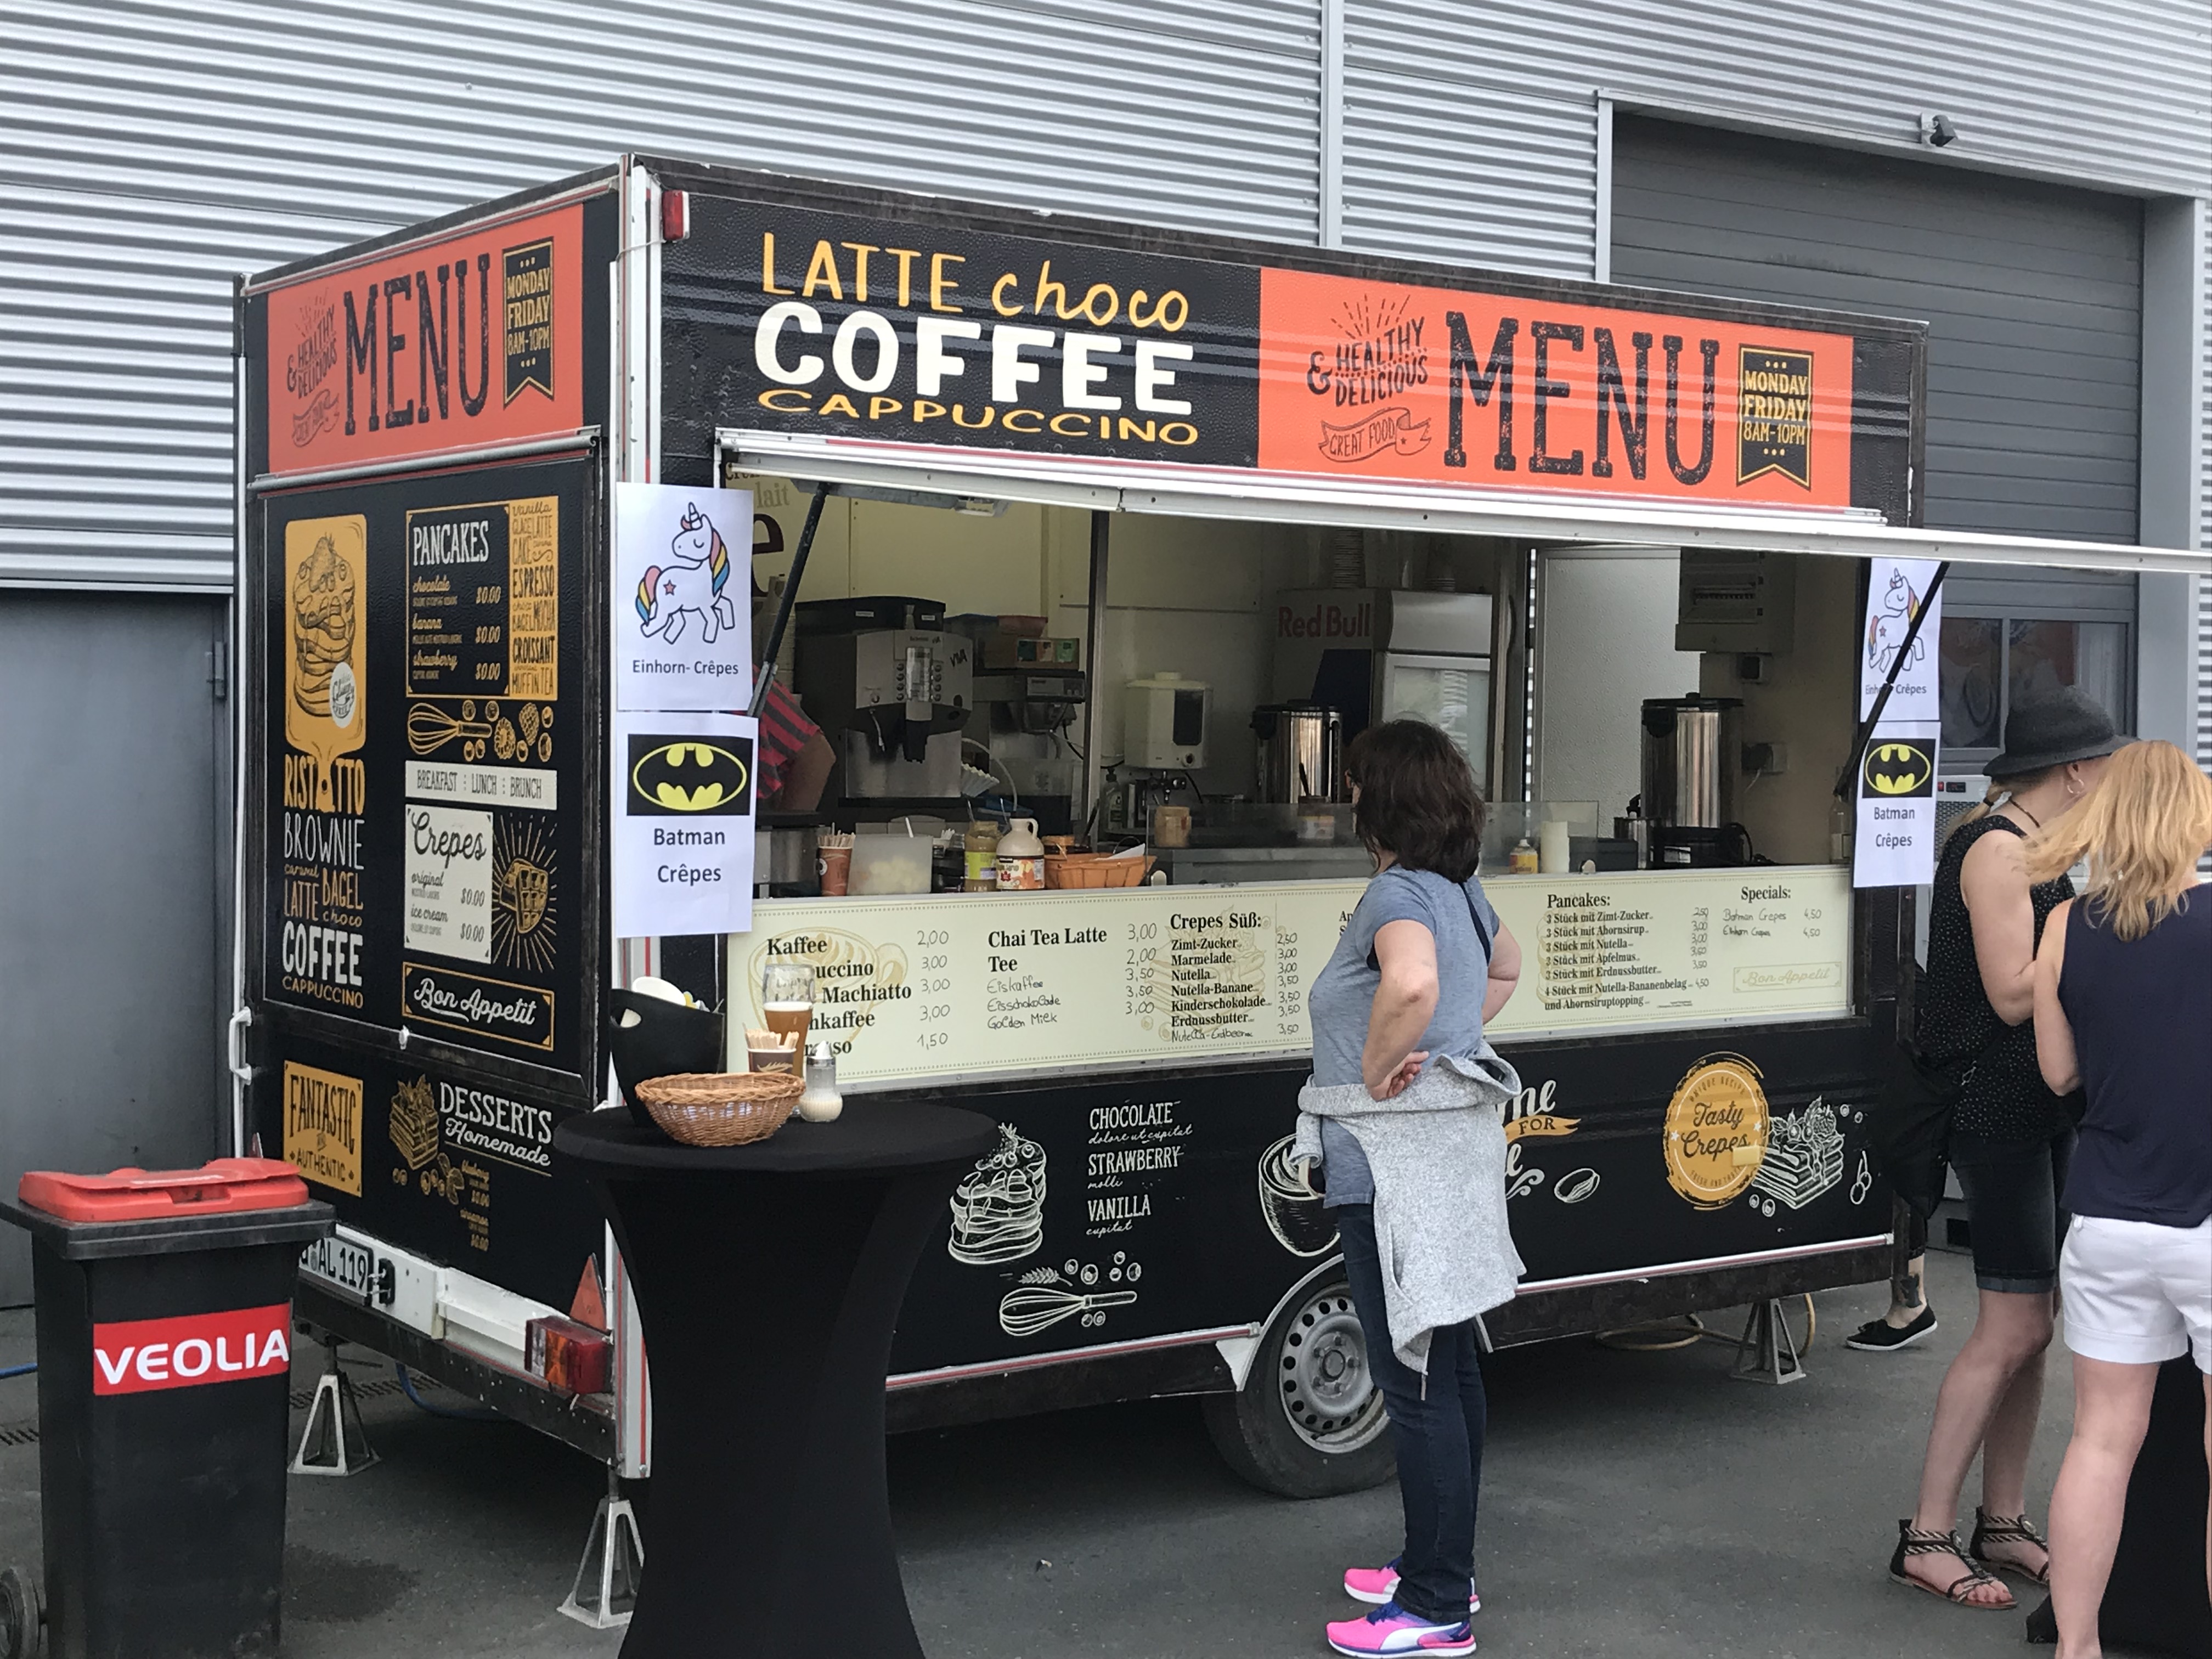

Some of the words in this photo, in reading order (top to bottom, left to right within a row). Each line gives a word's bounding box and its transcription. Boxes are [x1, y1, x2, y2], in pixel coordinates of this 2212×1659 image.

[506, 267, 550, 299] MONDAY
[763, 233, 966, 313] LATTE
[992, 261, 1189, 331] choco
[507, 295, 550, 329] FRIDAY
[344, 253, 490, 436] MENU
[507, 326, 550, 356] 8AM-10PM
[1336, 316, 1425, 371] HEALTHY
[755, 301, 1193, 415] COFFEE
[1307, 351, 1333, 394] &
[1335, 355, 1427, 407] DELICIOUS
[1744, 368, 1808, 396] MONDAY
[1444, 311, 1719, 484] MENU
[1743, 393, 1807, 422] FRIDAY
[758, 389, 1199, 445] CAPPUCCINO
[1369, 417, 1395, 448] FOOD
[1742, 420, 1806, 445] 8AM-10PM
[755, 481, 790, 509] lait
[413, 521, 489, 566] PANCAKES
[513, 565, 555, 598] ESPRESSO
[1278, 605, 1322, 638] Red
[1326, 603, 1370, 638] Bull
[512, 635, 555, 664] CROISSANT
[632, 659, 691, 675] Einhorn-
[694, 659, 739, 678] Crêpes
[1896, 684, 1927, 696] Crêpes
[417, 770, 458, 792] BREAKFAST
[472, 773, 497, 795] LUNCH
[510, 776, 542, 799] BRUNCH
[1874, 807, 1915, 820] Batman
[284, 812, 364, 870] BROWNIE
[409, 810, 487, 868] Crepes
[653, 827, 725, 847] Batman
[1876, 834, 1912, 848] Crêpes
[411, 871, 444, 889] original
[461, 888, 485, 907] $0.00
[657, 865, 722, 885] Crêpes
[284, 878, 319, 921] LATTE
[1547, 893, 1610, 908] Pancakes:
[1741, 885, 1791, 904] Specials:
[323, 909, 362, 927] choco
[411, 904, 422, 918] ice
[424, 909, 448, 922] cream
[1171, 913, 1222, 932] Crepes
[1229, 912, 1262, 928] Süß:
[1554, 912, 1578, 923] Stück
[1581, 911, 1595, 923] mit
[767, 936, 828, 956] Kaffee
[917, 930, 949, 947] 2,00
[988, 930, 1026, 947] Chai
[1031, 929, 1059, 945] Tea
[1065, 927, 1107, 944] Latte
[1127, 923, 1157, 943] 3,00
[1553, 940, 1577, 952] Stück
[1580, 940, 1594, 950] mit
[1596, 938, 1627, 949] Nutella
[1554, 927, 1578, 937] Stück
[1581, 926, 1595, 936] mit
[283, 921, 363, 987] COFFEE
[921, 955, 947, 970] 3,00
[988, 956, 1018, 972] Tee
[1127, 947, 1156, 966] 2,00
[1171, 952, 1232, 966] Marmelade
[1278, 948, 1297, 960] 3,00
[1553, 955, 1577, 966] Stück
[1580, 953, 1594, 964] mit
[1125, 968, 1154, 981] 3,50
[1171, 969, 1210, 981] Nutella
[1278, 962, 1297, 974] 3,00
[1553, 969, 1577, 979] Stück
[1579, 967, 1594, 978] mit
[283, 975, 363, 1009] CAPPUCCINO
[822, 984, 912, 1003] Machiatto
[920, 979, 951, 994] 3,00
[1125, 986, 1153, 998] 3,50
[1171, 983, 1254, 997] Nutella-Banane
[1278, 975, 1299, 988] 3,50
[1552, 985, 1577, 996] Stück
[1579, 983, 1593, 994] mit
[414, 978, 461, 1015] Bon
[461, 989, 537, 1025] Appetit
[919, 1004, 951, 1022] 3,00
[1125, 1001, 1154, 1015] 3,00
[1171, 996, 1266, 1012] Kinderschokolade
[1278, 991, 1300, 1004] 3,50
[1545, 999, 1561, 1011] und
[1171, 1013, 1249, 1028] Erdnussbutter
[1278, 1005, 1300, 1017] 3,50
[1278, 1023, 1299, 1035] 3,50
[917, 1032, 948, 1048] 1,50
[289, 1075, 356, 1155] FANTASTIC
[440, 1082, 552, 1144] DESSERTS
[1090, 1102, 1173, 1130] CHOCOLATE
[1519, 1117, 1556, 1135] FOR
[1693, 1101, 1743, 1130] Tasty
[444, 1117, 551, 1166] Homemade
[1681, 1130, 1751, 1162] Crepes
[297, 1151, 346, 1182] AUTHENTIC
[1088, 1146, 1181, 1176] STRAWBERRY
[1088, 1194, 1151, 1222] VANILLA
[340, 1247, 366, 1290] 119
[95, 1329, 290, 1385] VEOLIA
